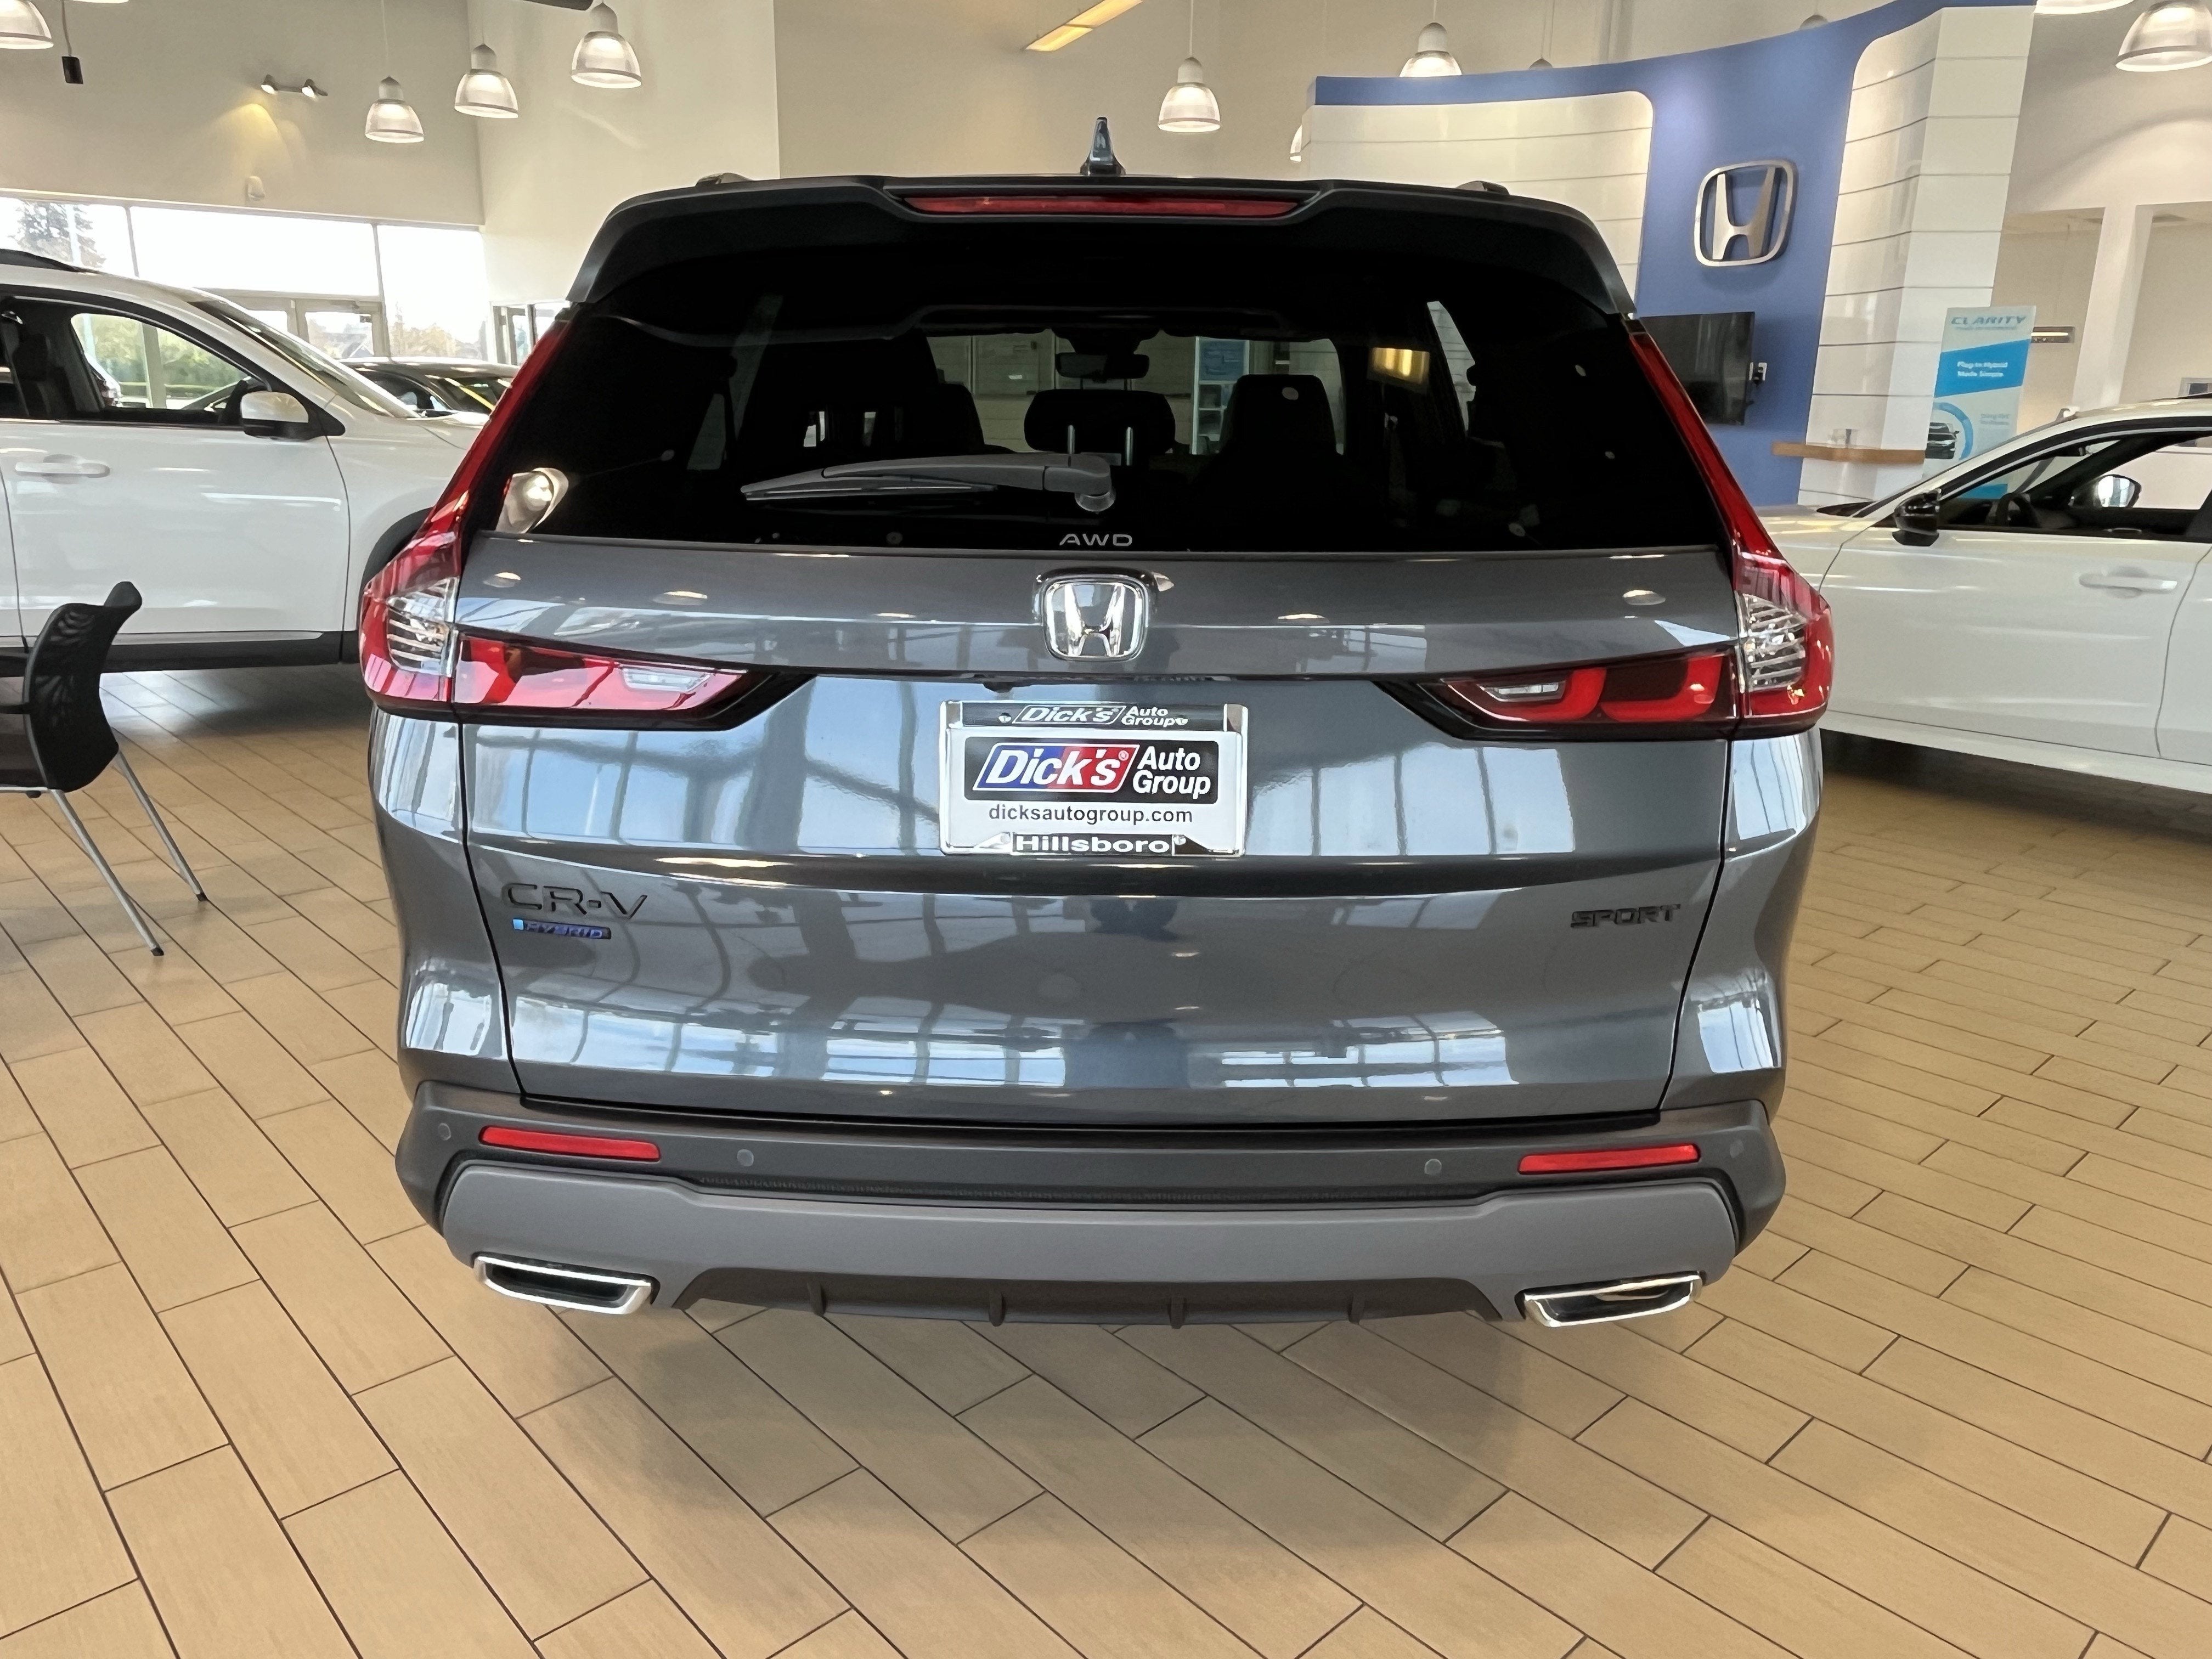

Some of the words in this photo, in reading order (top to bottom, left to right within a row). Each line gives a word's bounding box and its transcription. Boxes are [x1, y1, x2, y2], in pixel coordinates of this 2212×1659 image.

[1059, 533, 1133, 546] AWD
[1021, 706, 1114, 723] Dick's
[1121, 715, 1176, 728] Group
[1126, 706, 1169, 717] Auto
[985, 748, 1121, 787] Dick's
[1137, 746, 1201, 771] Auto
[1132, 769, 1211, 799] Group
[989, 804, 1193, 825] dicksautogroup.com
[1015, 834, 1170, 854] Hillsboro
[501, 882, 648, 920] CR-V
[1570, 904, 1681, 928] SPORT
